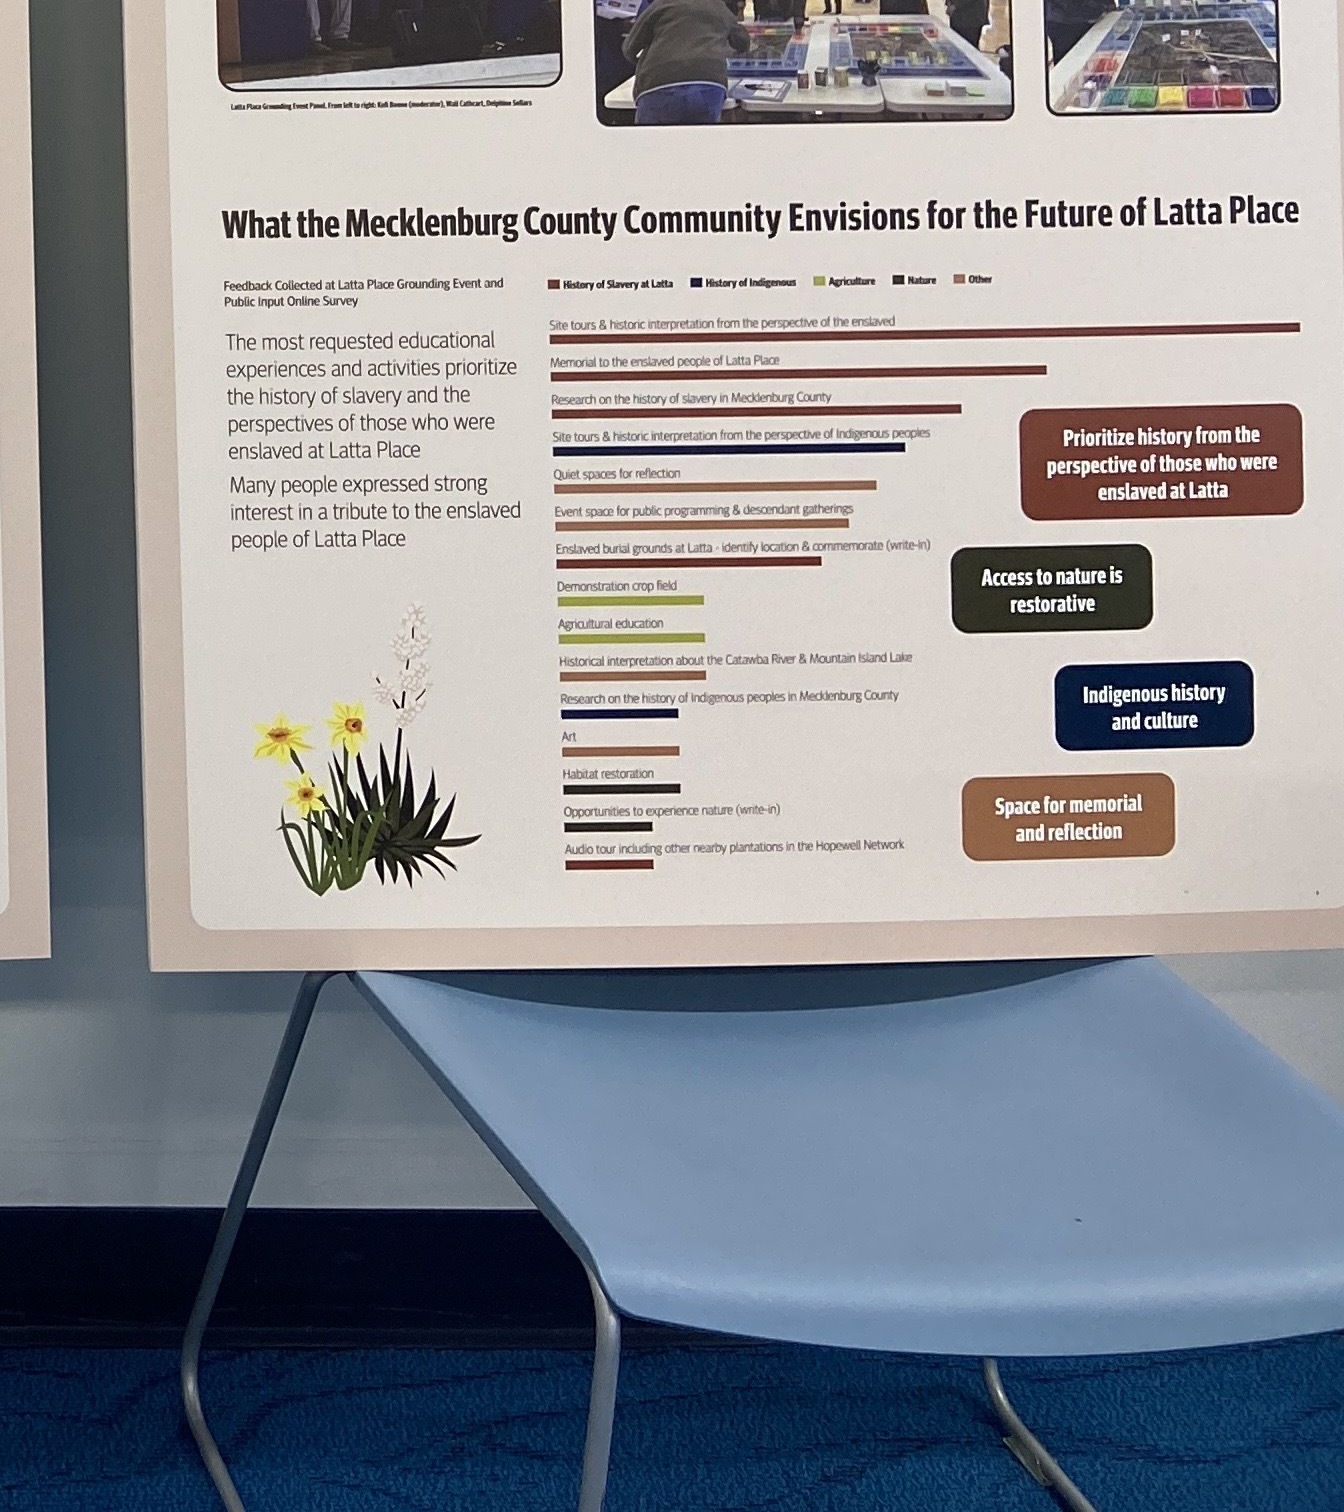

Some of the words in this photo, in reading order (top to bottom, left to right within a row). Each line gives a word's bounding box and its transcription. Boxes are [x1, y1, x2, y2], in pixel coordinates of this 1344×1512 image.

[220, 208, 292, 239] What
[295, 207, 340, 239] the
[344, 205, 519, 243] Mecklenburg
[522, 205, 618, 242] County
[622, 201, 782, 239] Community
[788, 199, 921, 232] Envisions
[925, 198, 967, 230] for
[972, 198, 1018, 229] the
[1024, 198, 1113, 228] Future
[1118, 195, 1147, 227] of
[1152, 196, 1223, 226] Latta
[1228, 193, 1299, 224] Place
[827, 275, 876, 288] Agriculture
[906, 274, 937, 285] Nature
[967, 273, 993, 284] Other
[555, 579, 630, 593] Demonstration
[630, 581, 655, 594] crop
[655, 578, 678, 591] field
[556, 617, 613, 632] Agricultural
[614, 616, 664, 630] education
[1082, 684, 1169, 707] Indigenous
[1170, 681, 1226, 705] history
[1110, 711, 1141, 731] and
[1143, 710, 1199, 730] culture
[560, 730, 577, 743] Art
[561, 767, 599, 780] Habitat
[599, 768, 655, 780] restoration
